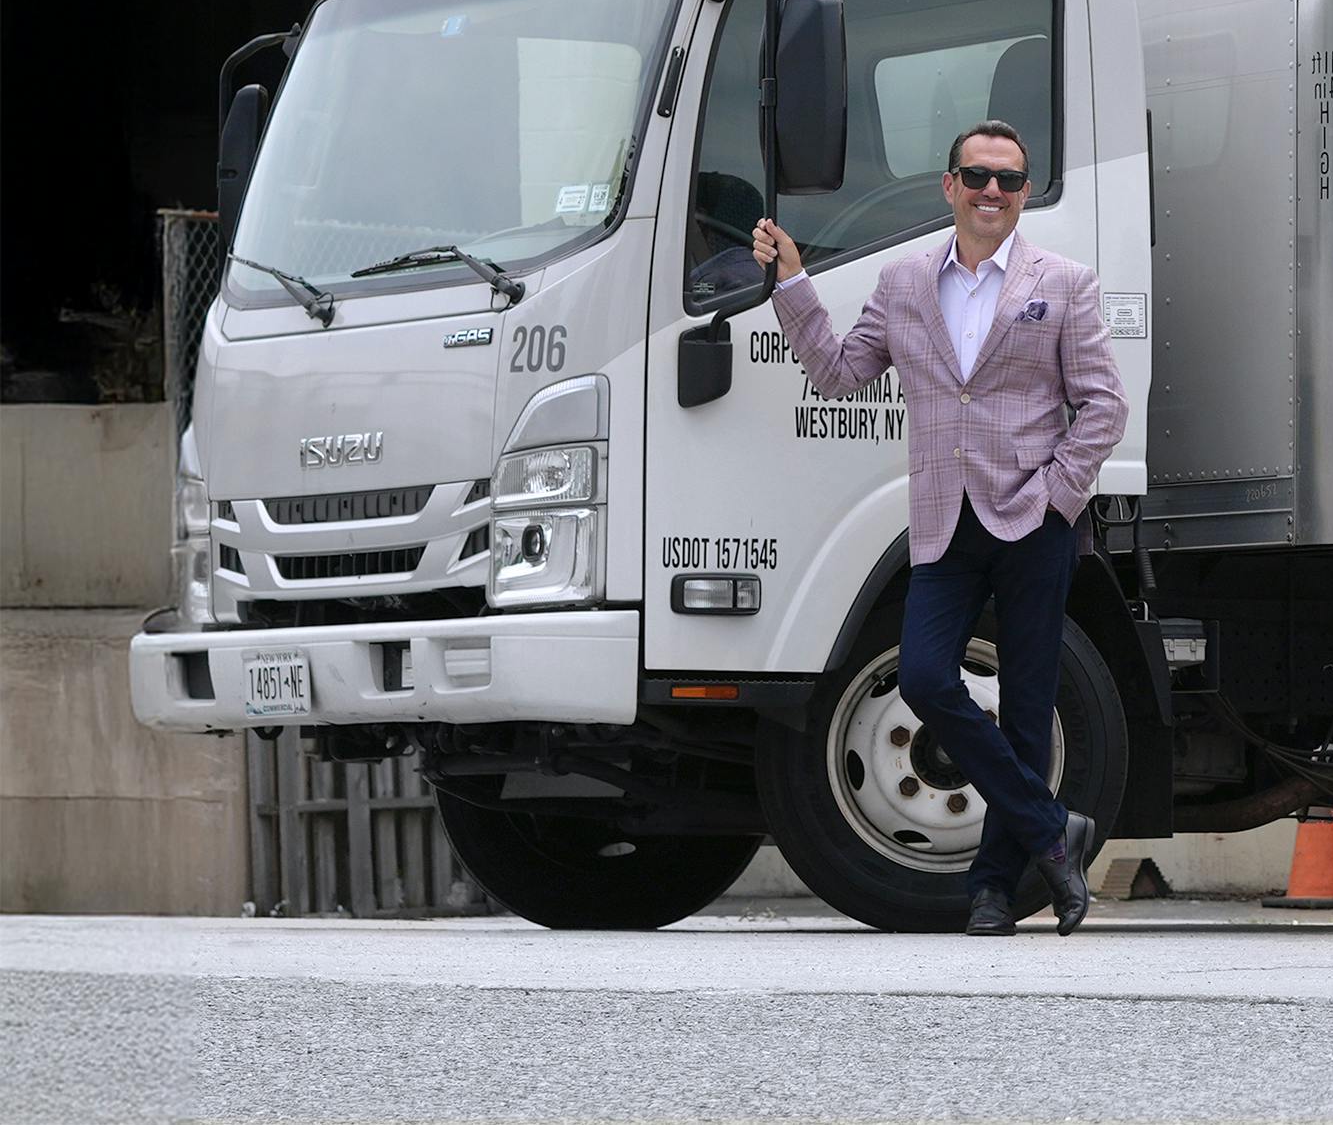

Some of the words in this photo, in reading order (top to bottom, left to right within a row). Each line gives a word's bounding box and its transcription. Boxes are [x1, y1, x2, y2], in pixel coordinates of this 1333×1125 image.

[509, 325, 567, 373] 206
[795, 406, 879, 445] WESTBURY,
[885, 409, 905, 441] NY
[300, 431, 384, 470] ISUZU
[662, 536, 710, 569] USDOT
[714, 538, 777, 570] 1571545
[249, 666, 282, 701] 14851
